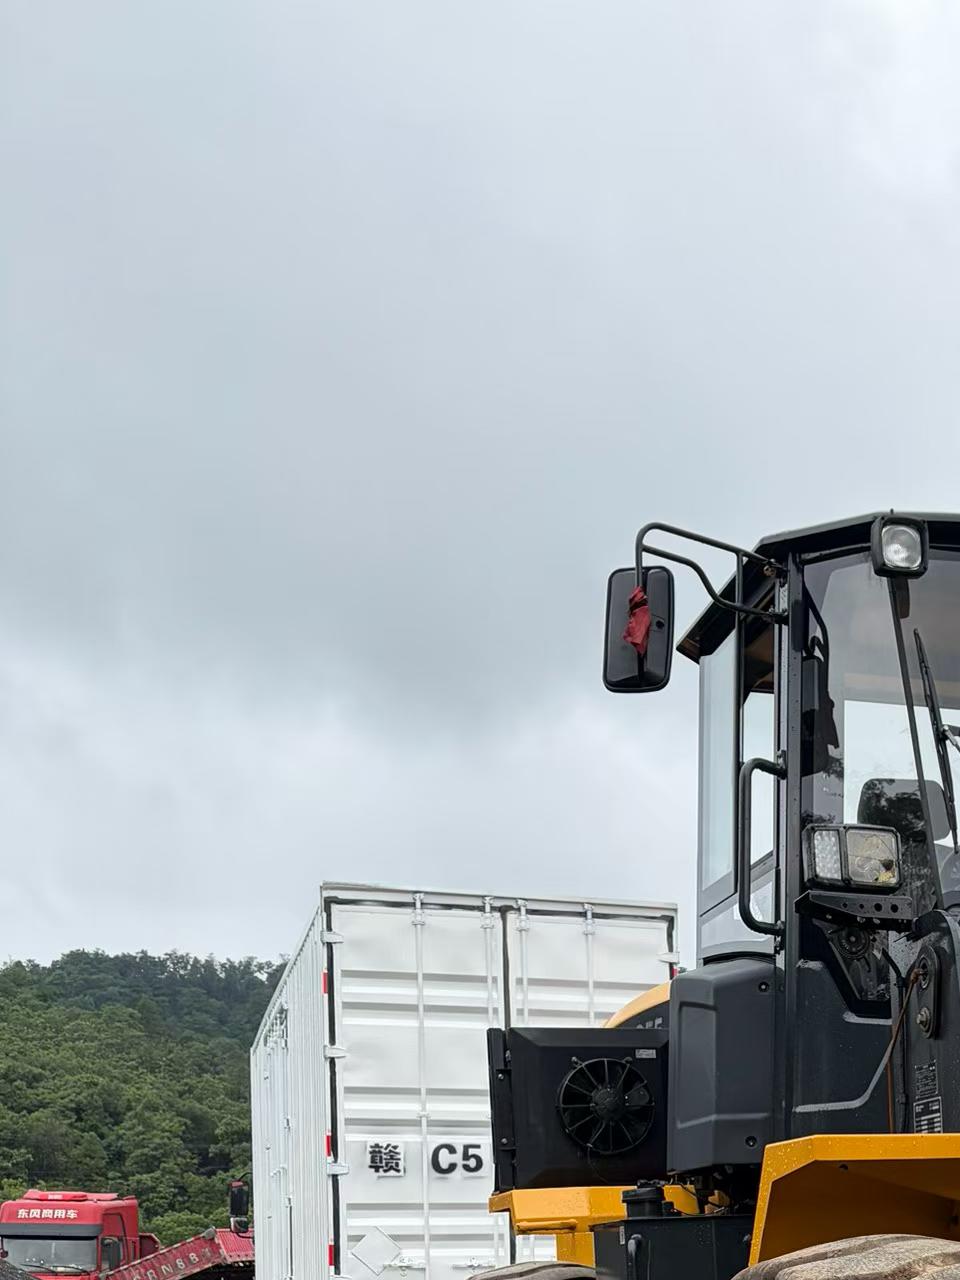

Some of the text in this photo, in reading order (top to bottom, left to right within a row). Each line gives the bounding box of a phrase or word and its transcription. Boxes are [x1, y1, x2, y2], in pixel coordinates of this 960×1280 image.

[369, 1143, 484, 1175] 赣 C5
[17, 1208, 78, 1219] 东风商用车
